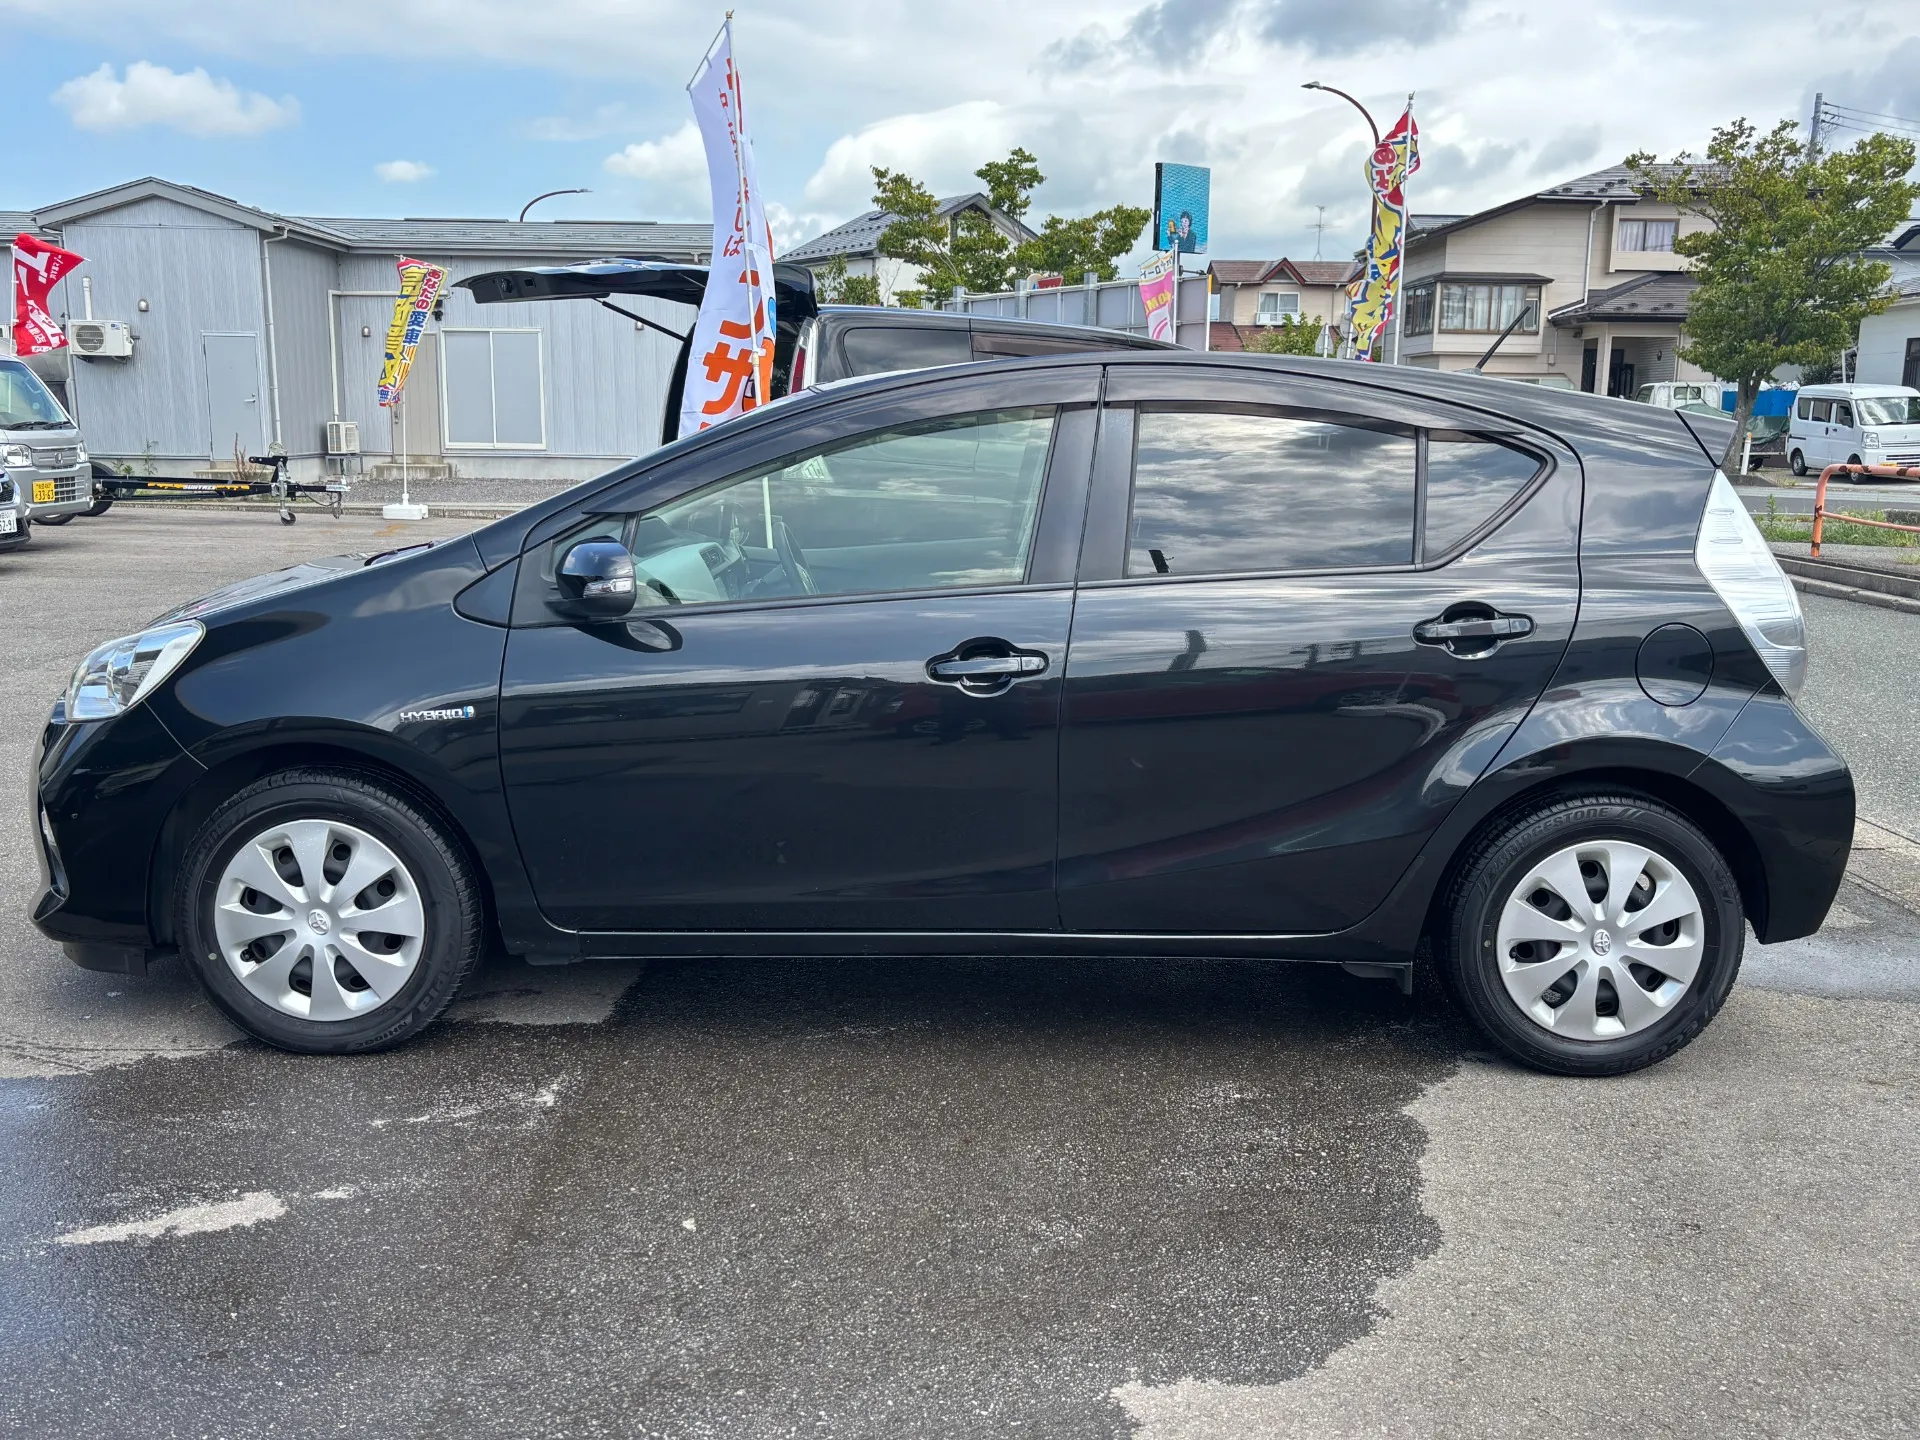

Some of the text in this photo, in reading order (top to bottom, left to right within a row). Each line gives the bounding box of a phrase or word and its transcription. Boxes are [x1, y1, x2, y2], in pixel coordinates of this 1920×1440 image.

[402, 268, 443, 346] あなたの愛車
[400, 708, 463, 722] HYBRID
